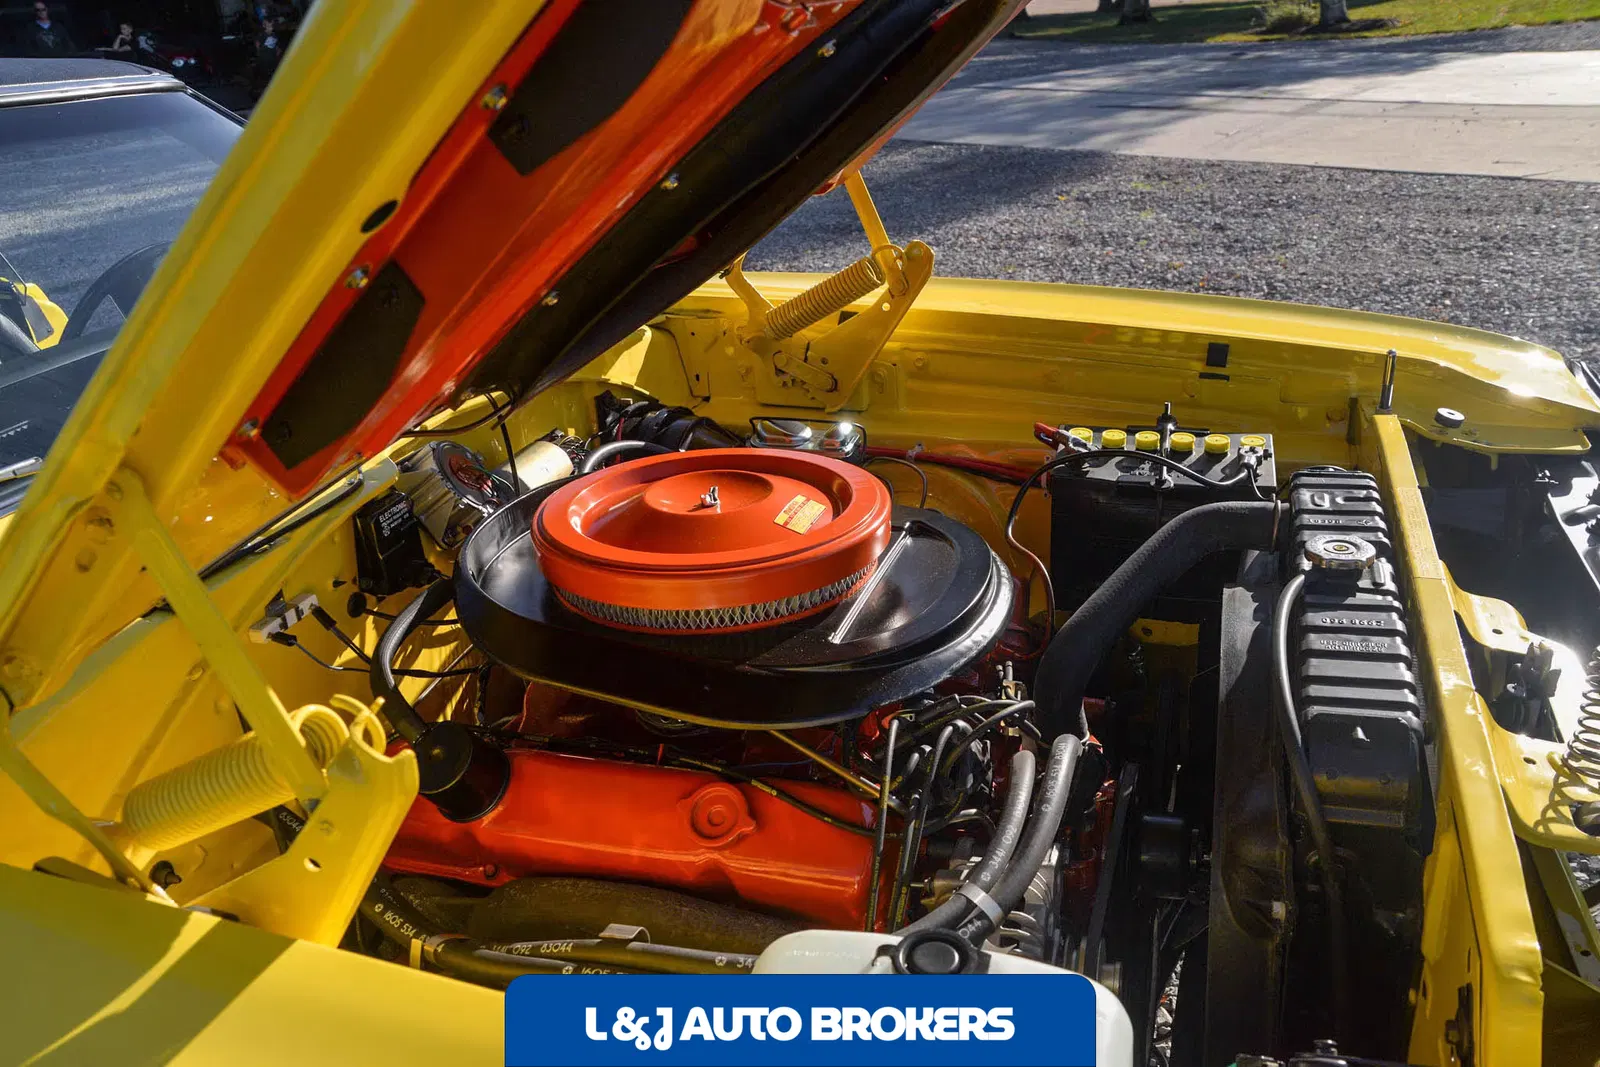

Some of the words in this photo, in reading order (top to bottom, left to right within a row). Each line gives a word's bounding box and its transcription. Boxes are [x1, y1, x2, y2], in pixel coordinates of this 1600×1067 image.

[1044, 780, 1058, 798] 1605
[988, 847, 1006, 869] 3441
[1002, 825, 1018, 844] 092
[383, 910, 404, 928] 1605
[400, 923, 417, 938] 534
[957, 918, 982, 939] 044
[512, 944, 532, 955] 092
[540, 942, 574, 953] 83044
[736, 956, 753, 969] 34
